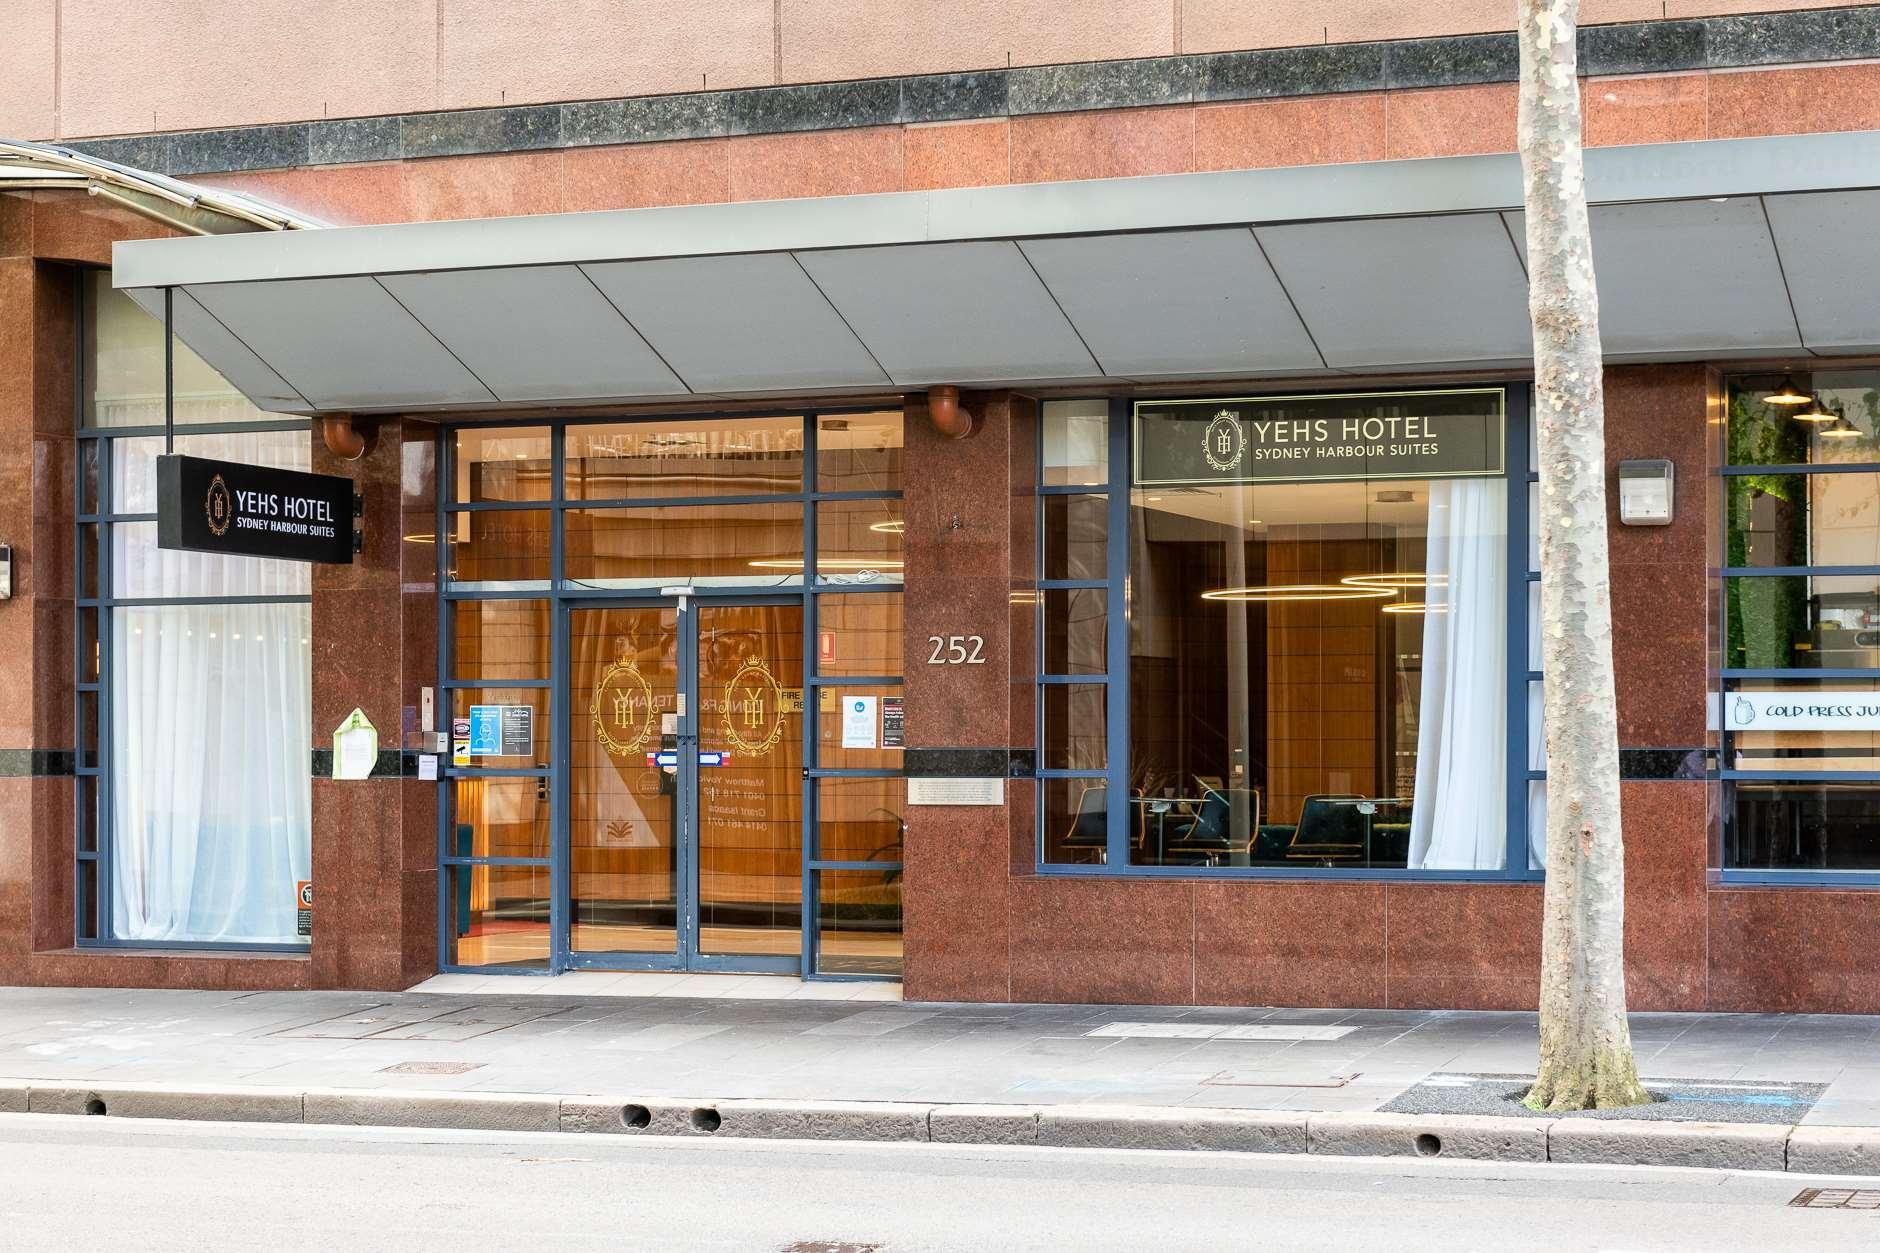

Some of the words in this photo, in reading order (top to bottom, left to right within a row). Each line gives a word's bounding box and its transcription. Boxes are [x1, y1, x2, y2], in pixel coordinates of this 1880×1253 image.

[1254, 420, 1328, 444] YEHS
[1343, 417, 1437, 441] HOTEL
[1255, 446, 1311, 460] SYDNEY
[1316, 444, 1384, 458] HARBOUR
[1390, 443, 1439, 456] SUITES
[236, 489, 278, 516] YEHS
[284, 496, 334, 522] HOTEL
[236, 516, 268, 531] SYDNEY
[270, 520, 308, 536] HARBOUR
[309, 524, 335, 538] SUITES
[927, 635, 986, 664] 252
[781, 691, 800, 700] FIRE
[1766, 705, 1804, 717] COLD
[1809, 705, 1852, 717] PRESS
